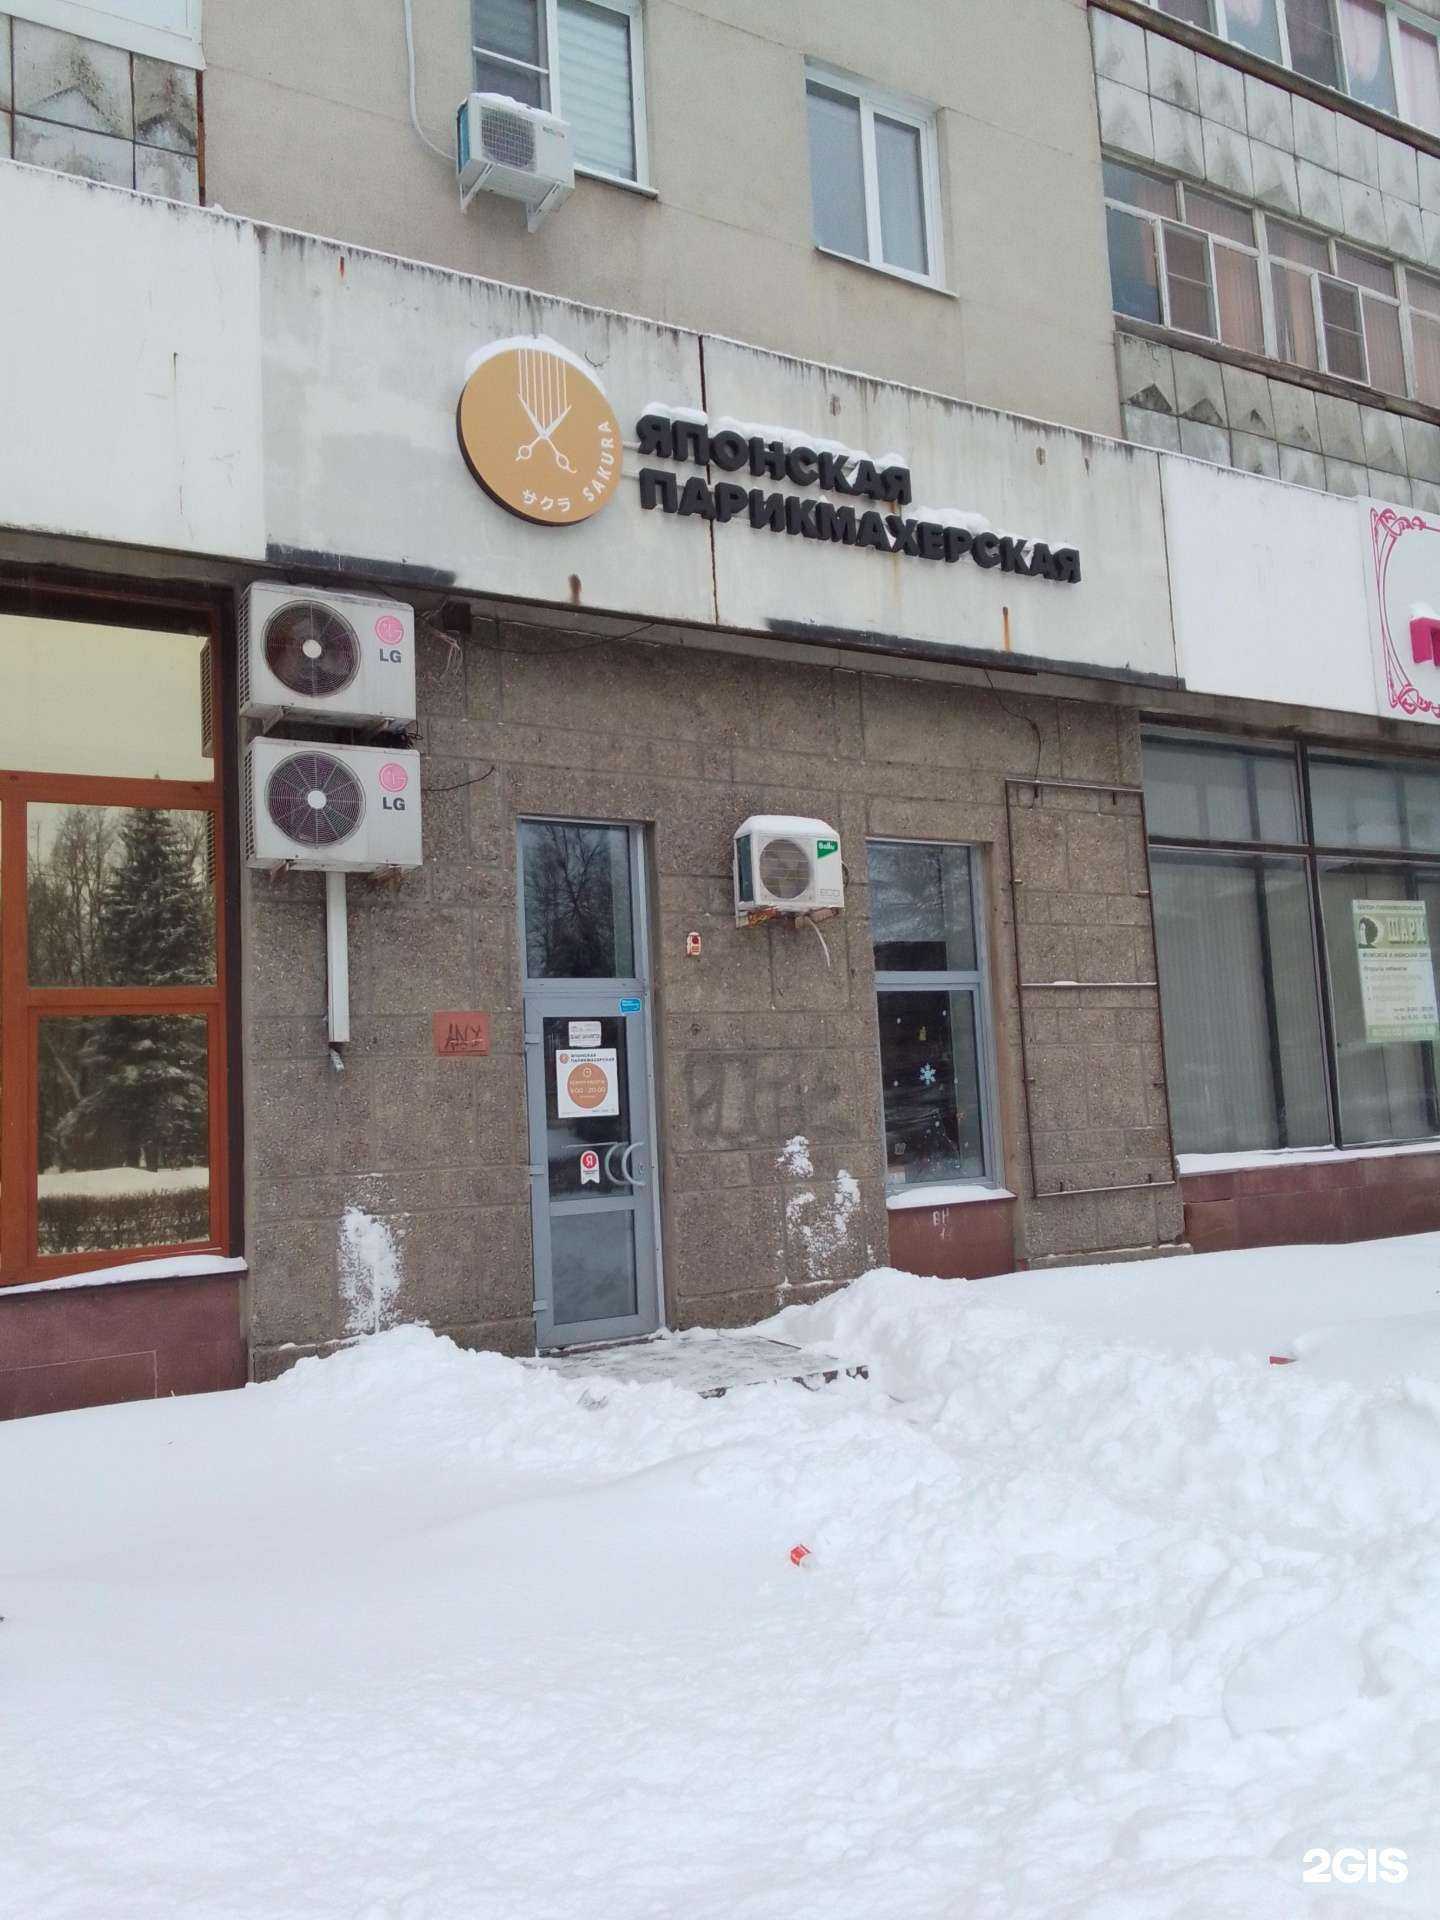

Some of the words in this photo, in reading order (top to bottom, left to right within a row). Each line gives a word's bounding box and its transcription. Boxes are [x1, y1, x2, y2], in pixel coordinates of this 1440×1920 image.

[582, 421, 615, 502] SAKURA
[636, 414, 912, 505] ЯПОНСКАЯ
[522, 489, 570, 512] サクラ
[639, 467, 1081, 584] ПАРИКМАХЕРСКАЯ
[380, 648, 401, 663] LG
[383, 797, 405, 810] LG
